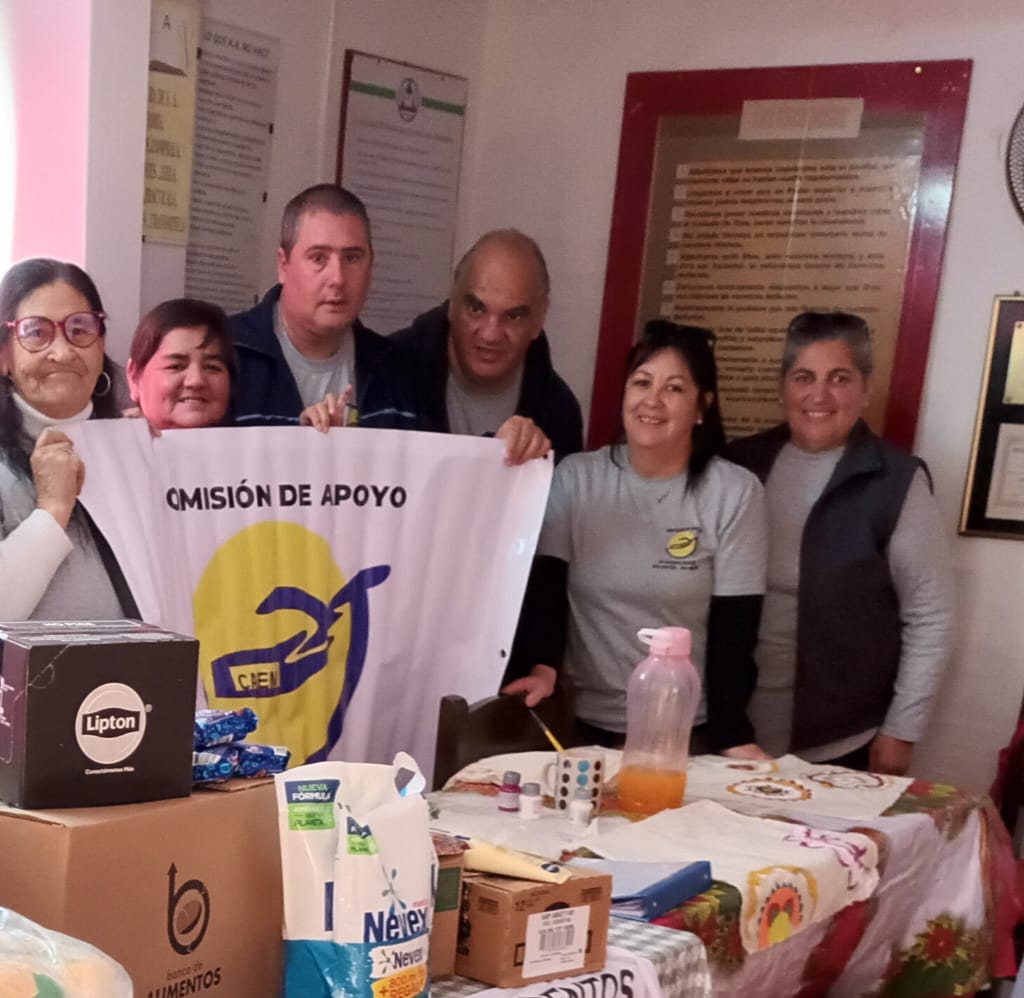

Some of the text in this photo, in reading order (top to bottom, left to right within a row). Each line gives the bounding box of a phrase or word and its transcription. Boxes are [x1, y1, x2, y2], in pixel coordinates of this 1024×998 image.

[279, 484, 312, 507] DE
[321, 483, 407, 508] APOYO
[86, 714, 136, 735] Lipton
[298, 784, 328, 792] NUEVA
